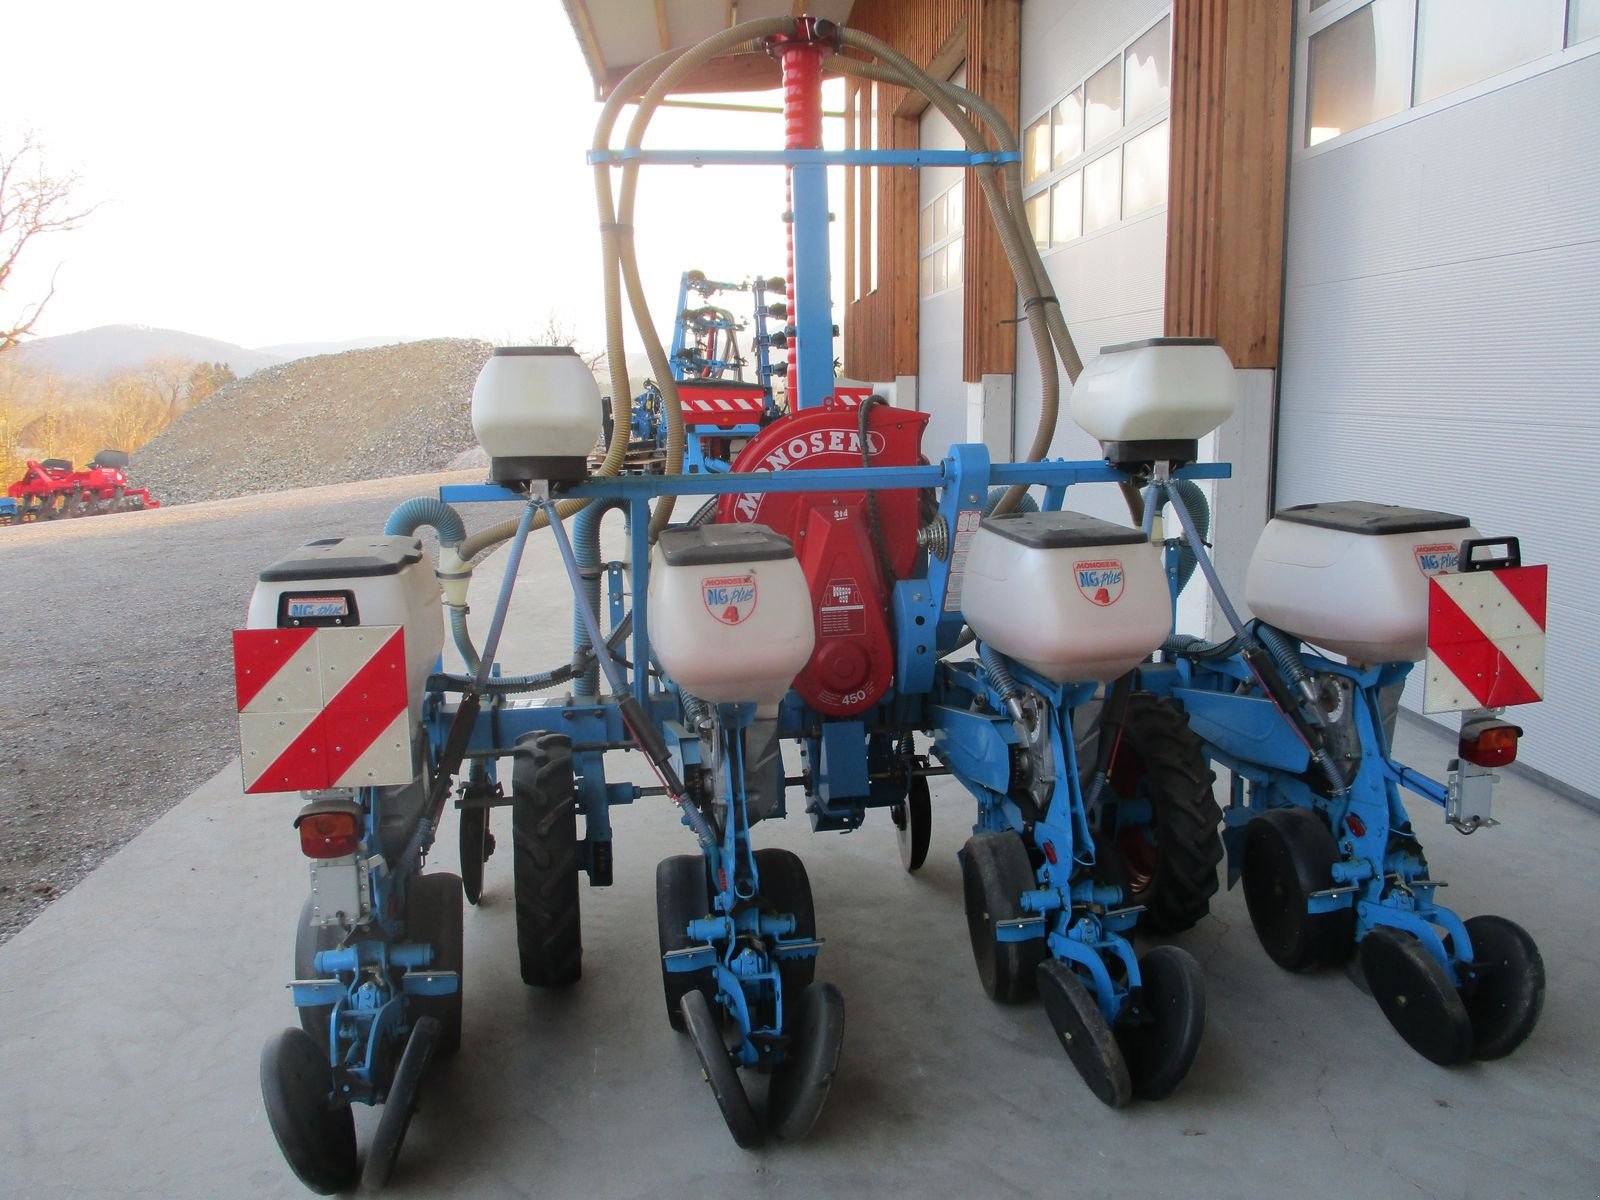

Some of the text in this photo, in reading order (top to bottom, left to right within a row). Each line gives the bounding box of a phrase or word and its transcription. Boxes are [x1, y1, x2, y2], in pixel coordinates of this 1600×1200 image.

[833, 508, 848, 518] Std
[1076, 561, 1120, 570] MONOSEM
[1420, 555, 1439, 569] NG
[1079, 571, 1099, 587] NG
[707, 588, 728, 606] NG
[842, 690, 866, 705] 450
